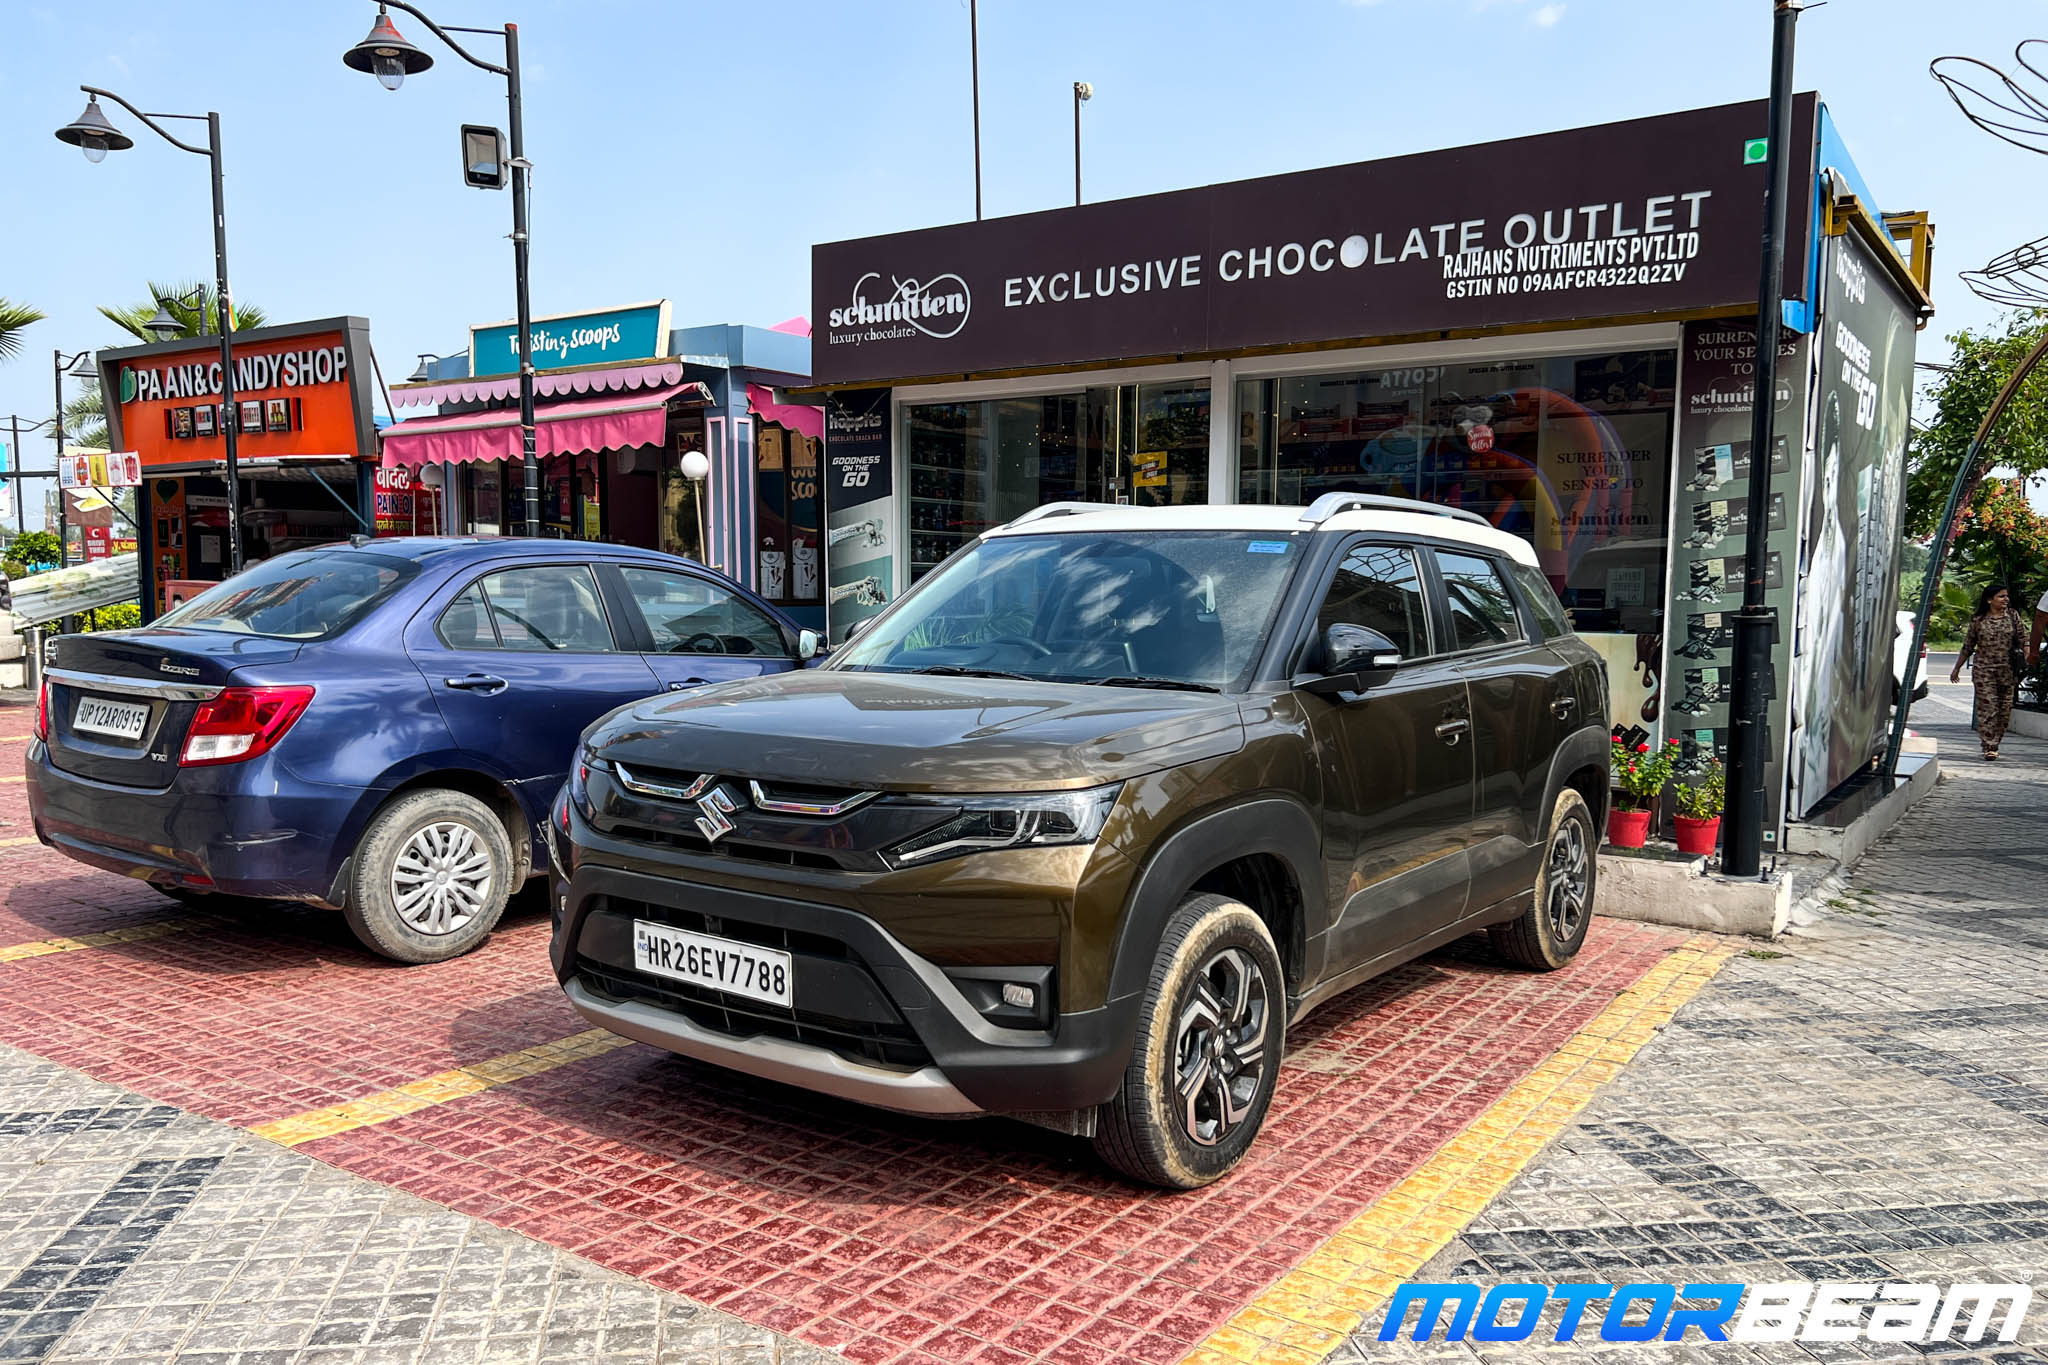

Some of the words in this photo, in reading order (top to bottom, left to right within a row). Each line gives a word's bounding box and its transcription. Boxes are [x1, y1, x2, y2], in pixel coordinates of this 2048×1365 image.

[1004, 255, 1201, 307] EXCLUSIVE
[1219, 219, 1486, 282] CHOCOLATE
[1503, 191, 1712, 249] OUTLET
[1443, 249, 1513, 279] RAJHANS
[1516, 238, 1627, 273] NUTRIMENTS
[1446, 277, 1492, 298] GSTIN
[1496, 275, 1519, 295] NO
[1522, 263, 1687, 292] 09AAFCR4322Q2ZV
[829, 280, 968, 329] schmitten
[509, 329, 569, 360] Tisting
[829, 331, 863, 346] luxury
[864, 325, 917, 341] chocolates
[1698, 328, 1793, 345] SURRENR
[1694, 348, 1734, 361] YOUR
[1737, 343, 1797, 359] SEES
[1835, 321, 1871, 374] GOODNESS
[1730, 362, 1754, 375] TO
[1856, 376, 1878, 431] GO
[832, 455, 881, 466] GOODNESS
[1557, 449, 1652, 464] SURRENDER
[855, 464, 869, 472] THE
[1583, 463, 1625, 477] YOUR
[842, 472, 870, 488] GO
[1562, 477, 1618, 492] SENSES
[1624, 477, 1644, 490] TO
[376, 492, 400, 515] PAIN
[81, 702, 145, 732] UP12AR0915
[647, 935, 786, 996] HR26EV7788
